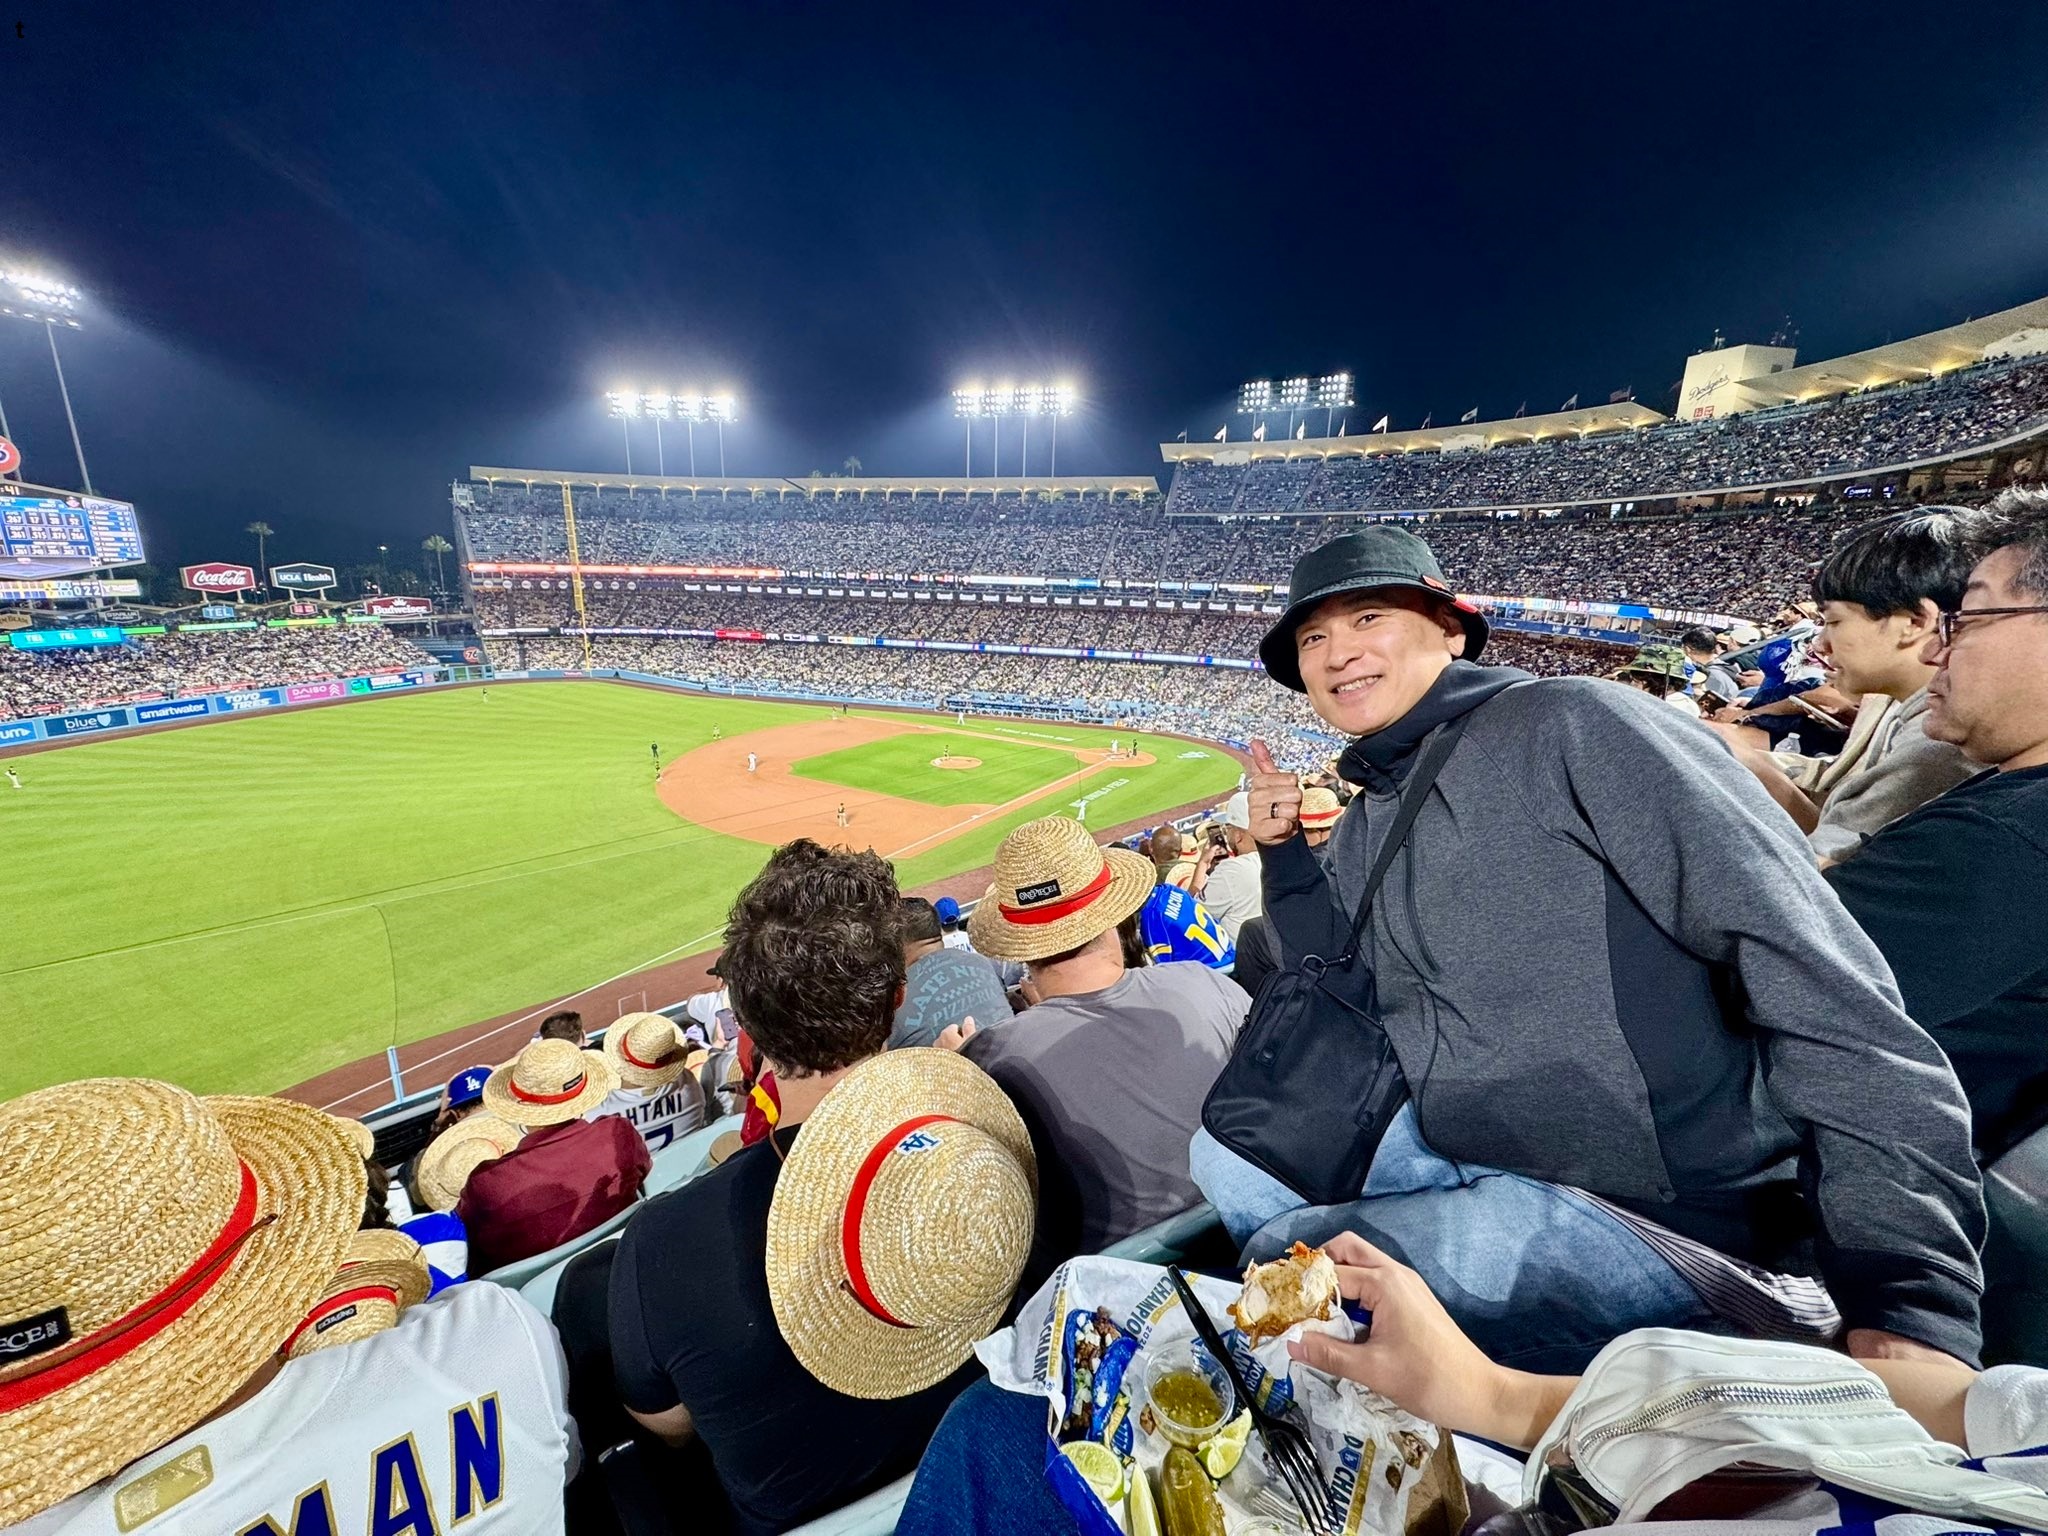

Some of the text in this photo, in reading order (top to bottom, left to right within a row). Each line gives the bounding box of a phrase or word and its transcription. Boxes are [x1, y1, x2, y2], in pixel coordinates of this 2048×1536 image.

[1688, 374, 1731, 400] Dodgers
[193, 570, 247, 586] Coca-Cola
[280, 573, 332, 582] UCLA Health
[206, 608, 230, 617] TEL
[373, 604, 428, 614] Budweiser
[225, 693, 260, 703] TOYO
[232, 698, 270, 710] TIRES
[140, 702, 206, 720] smartwater
[64, 716, 97, 729] blue
[1184, 903, 1230, 962] 12
[905, 971, 951, 1028] LATE
[932, 988, 998, 1027] PIZZERIA
[465, 1075, 481, 1091] LA
[613, 1093, 683, 1126] HTANI
[898, 1131, 941, 1152] LA
[1126, 1275, 1175, 1336] CHAMPIO
[1032, 1324, 1053, 1383] CHAMP
